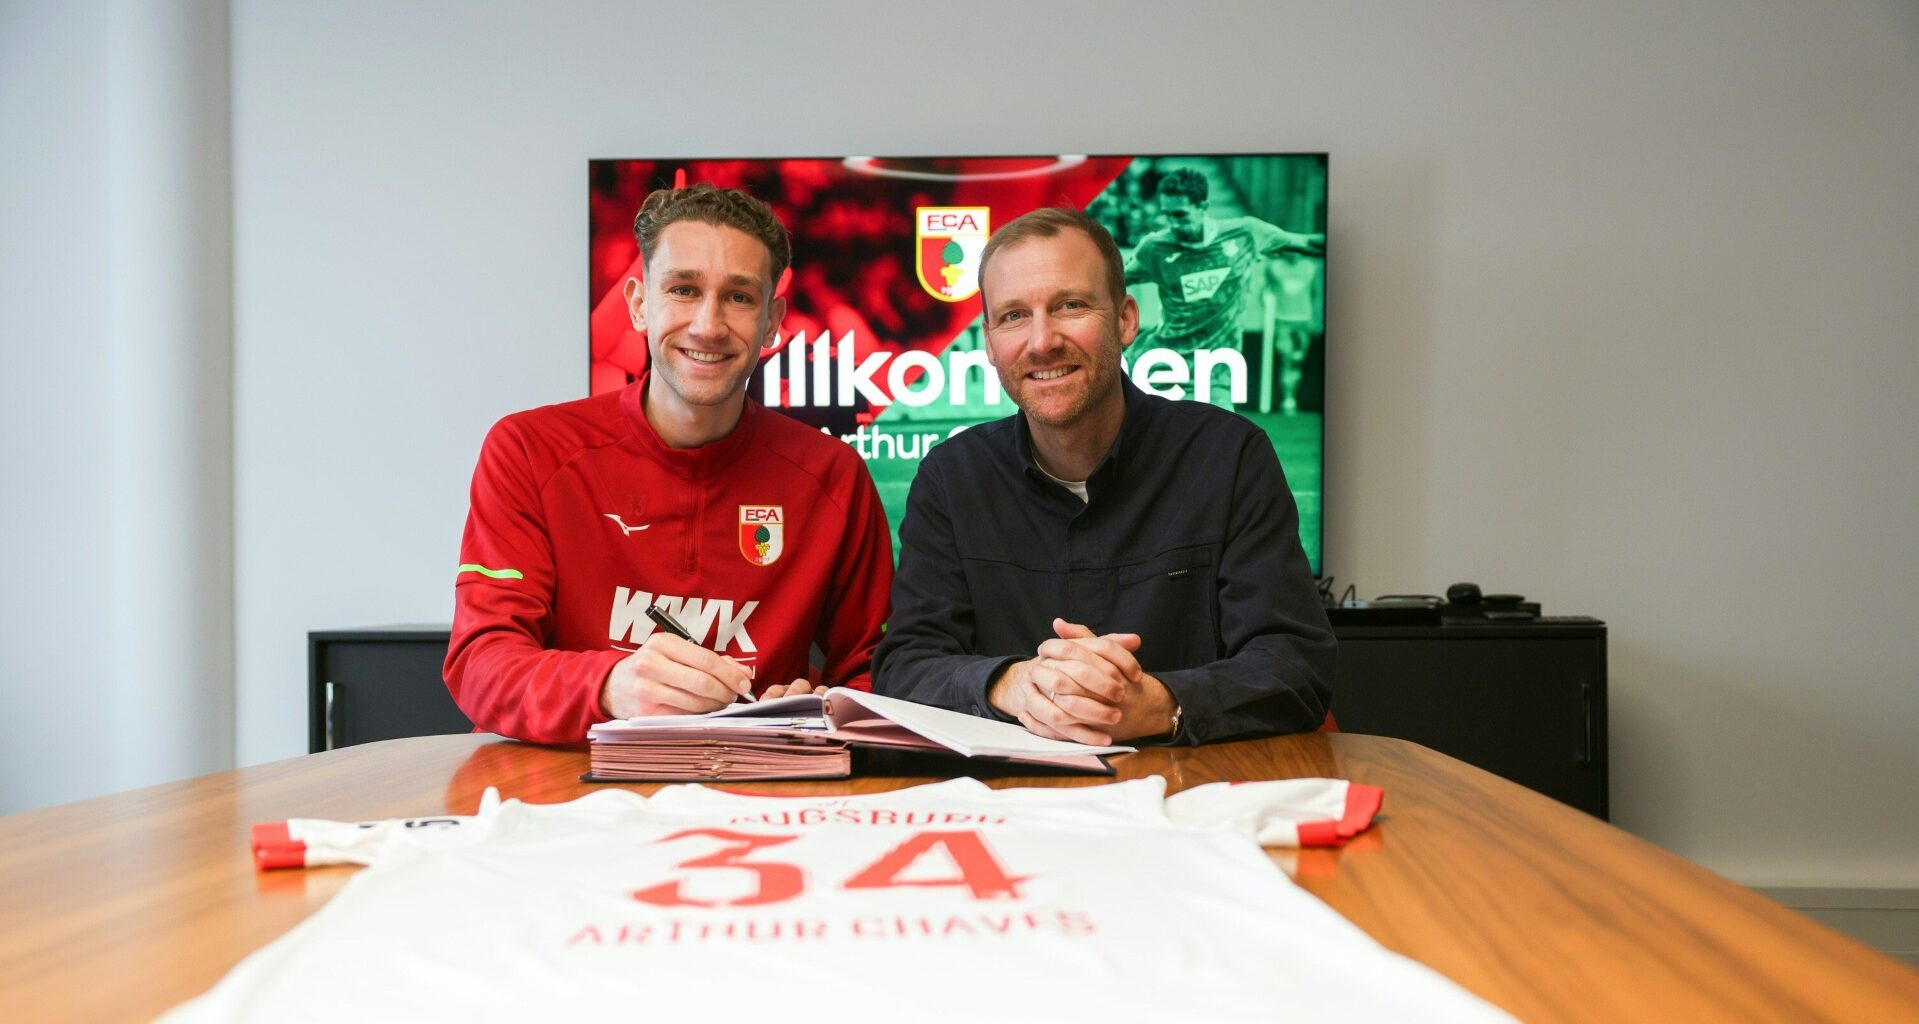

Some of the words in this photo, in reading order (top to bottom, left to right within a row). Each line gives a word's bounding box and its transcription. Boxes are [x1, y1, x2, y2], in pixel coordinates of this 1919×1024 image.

[926, 213, 979, 232] FCA
[1184, 274, 1220, 296] SAP
[744, 508, 780, 522] FCA
[608, 585, 761, 653] WWK
[630, 827, 1044, 910] 34
[565, 917, 829, 947] ARTHUR
[852, 909, 1098, 938] CHAVES
